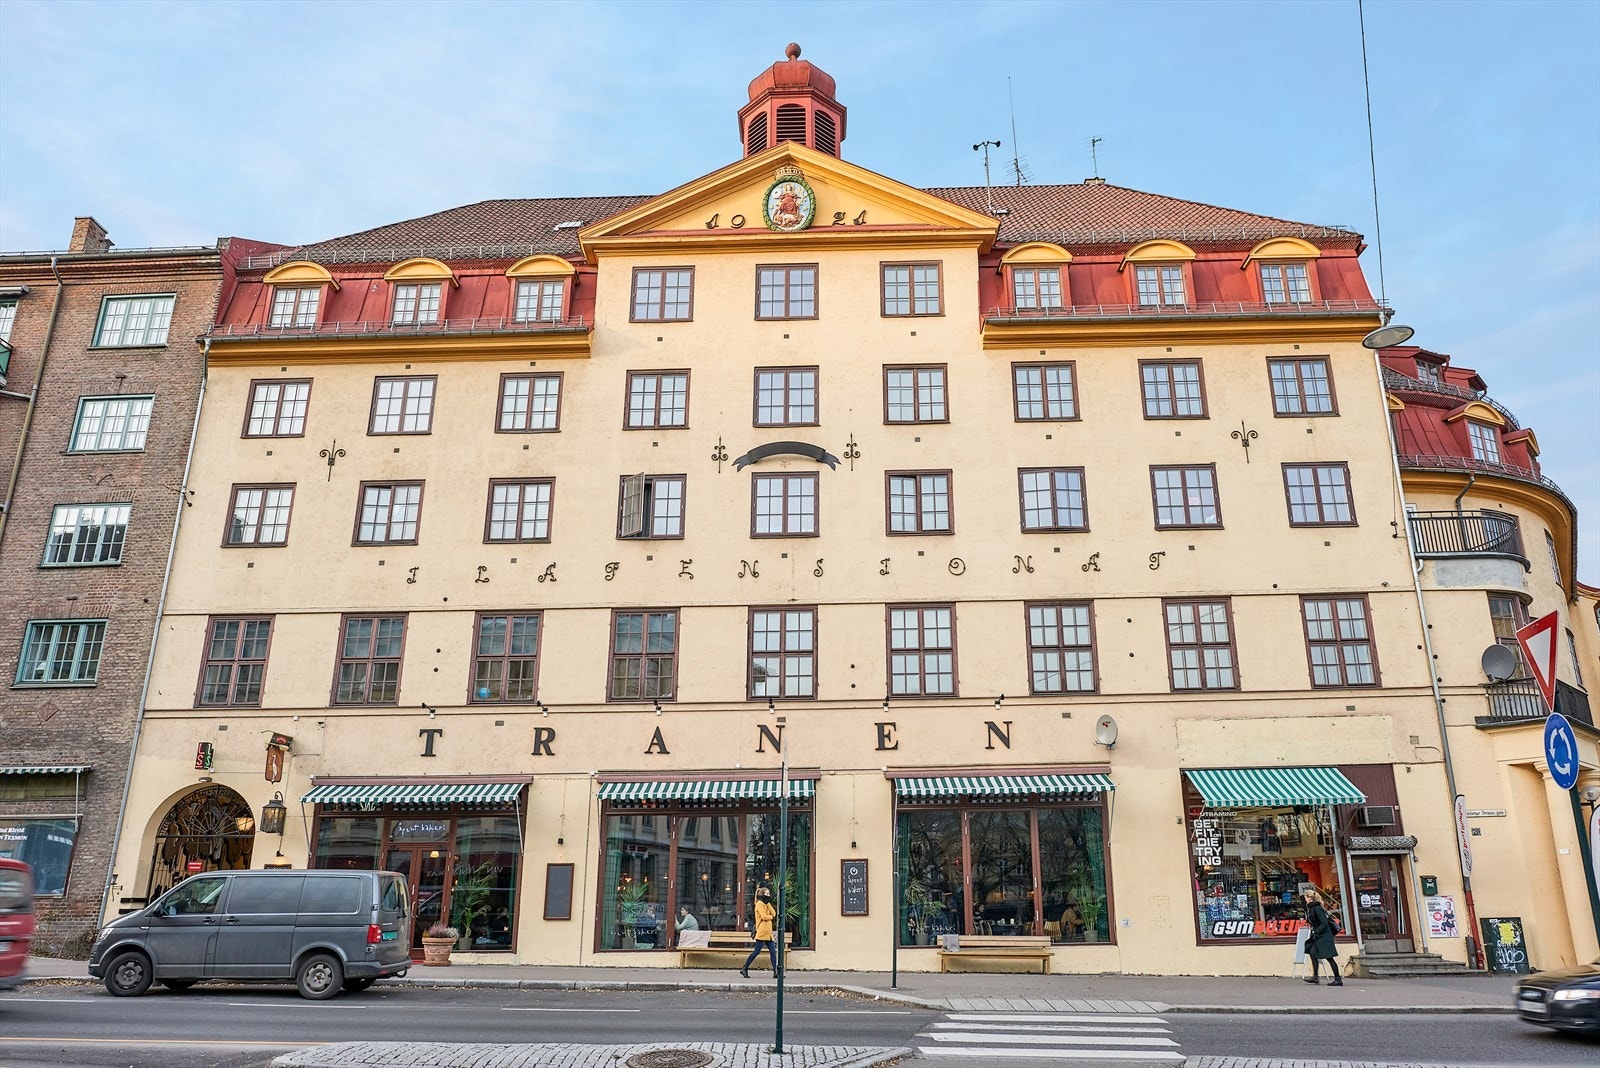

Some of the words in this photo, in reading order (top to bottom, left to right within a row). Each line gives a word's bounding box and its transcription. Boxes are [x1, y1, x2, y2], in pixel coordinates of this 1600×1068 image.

[419, 721, 1013, 757] TRANEN
[1194, 819, 1219, 828] GET
[1196, 829, 1214, 837] FIT
[1198, 838, 1219, 847] DIE
[1196, 847, 1222, 856] TRY
[1199, 857, 1221, 865] ING
